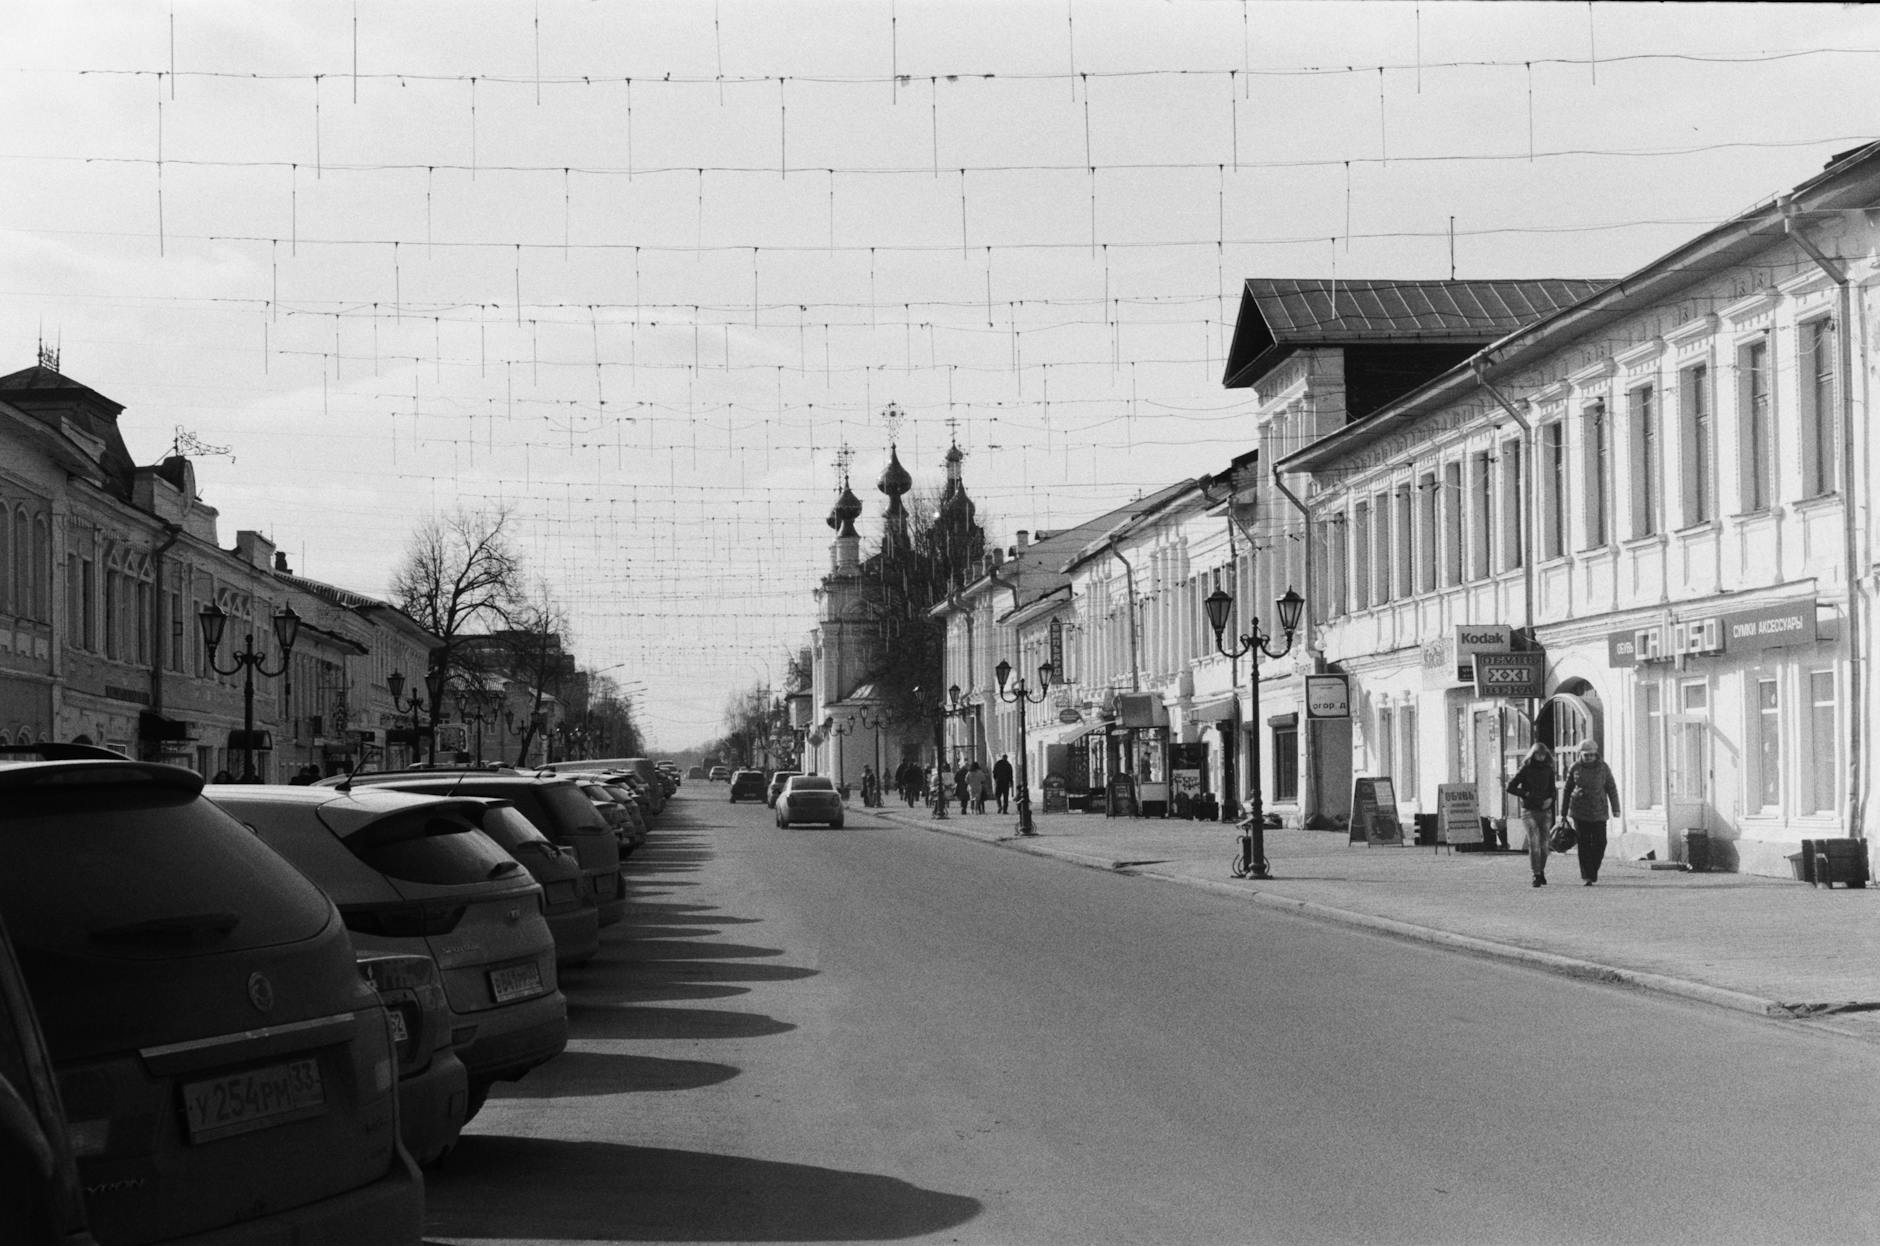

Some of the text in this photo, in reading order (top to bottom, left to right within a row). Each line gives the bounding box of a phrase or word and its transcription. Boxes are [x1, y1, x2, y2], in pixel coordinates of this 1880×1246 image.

[1733, 615, 1803, 638] СУМКИ АКСЕССУАРЫ
[1461, 633, 1504, 644] Kodak
[1489, 668, 1530, 683] XXI
[1312, 702, 1346, 710] огорд
[1445, 791, 1474, 801] ОБУВЬ
